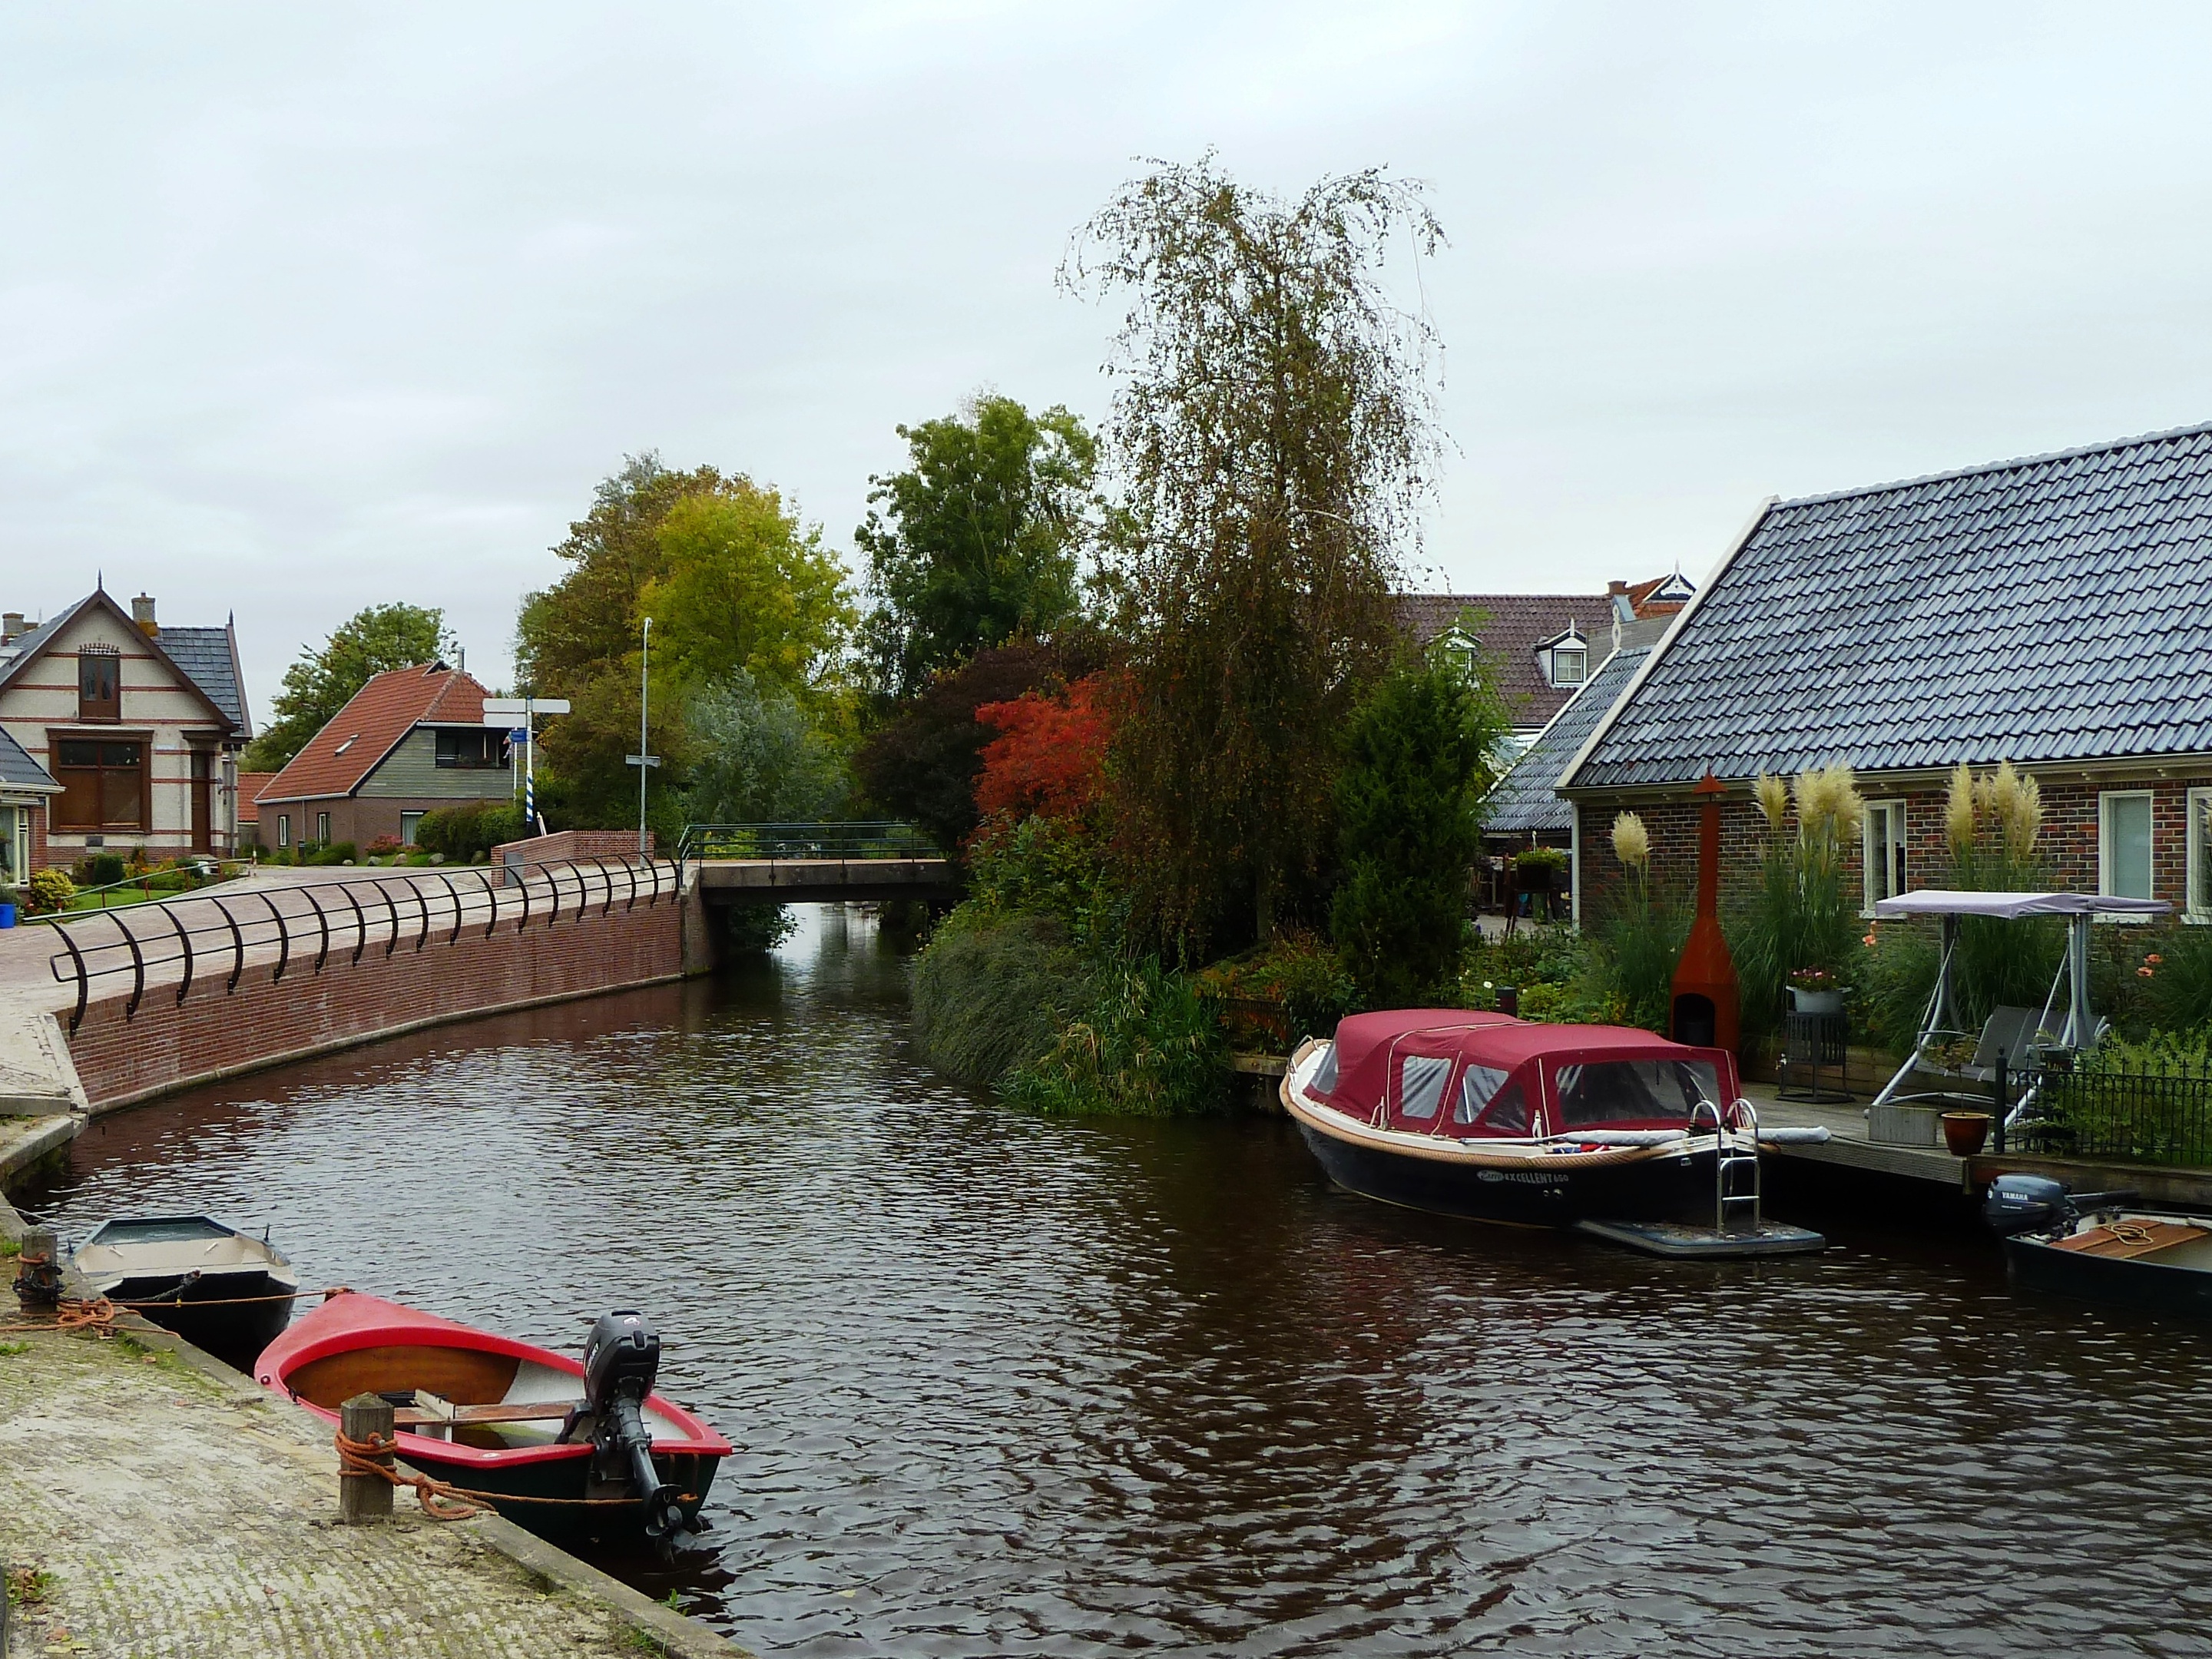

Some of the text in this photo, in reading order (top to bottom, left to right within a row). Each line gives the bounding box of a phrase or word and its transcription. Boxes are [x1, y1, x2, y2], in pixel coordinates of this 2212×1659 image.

[1505, 1173, 1552, 1184] EXCELLENT
[1553, 1174, 1569, 1183] 650
[2002, 1191, 2028, 1200] YAMAHA
